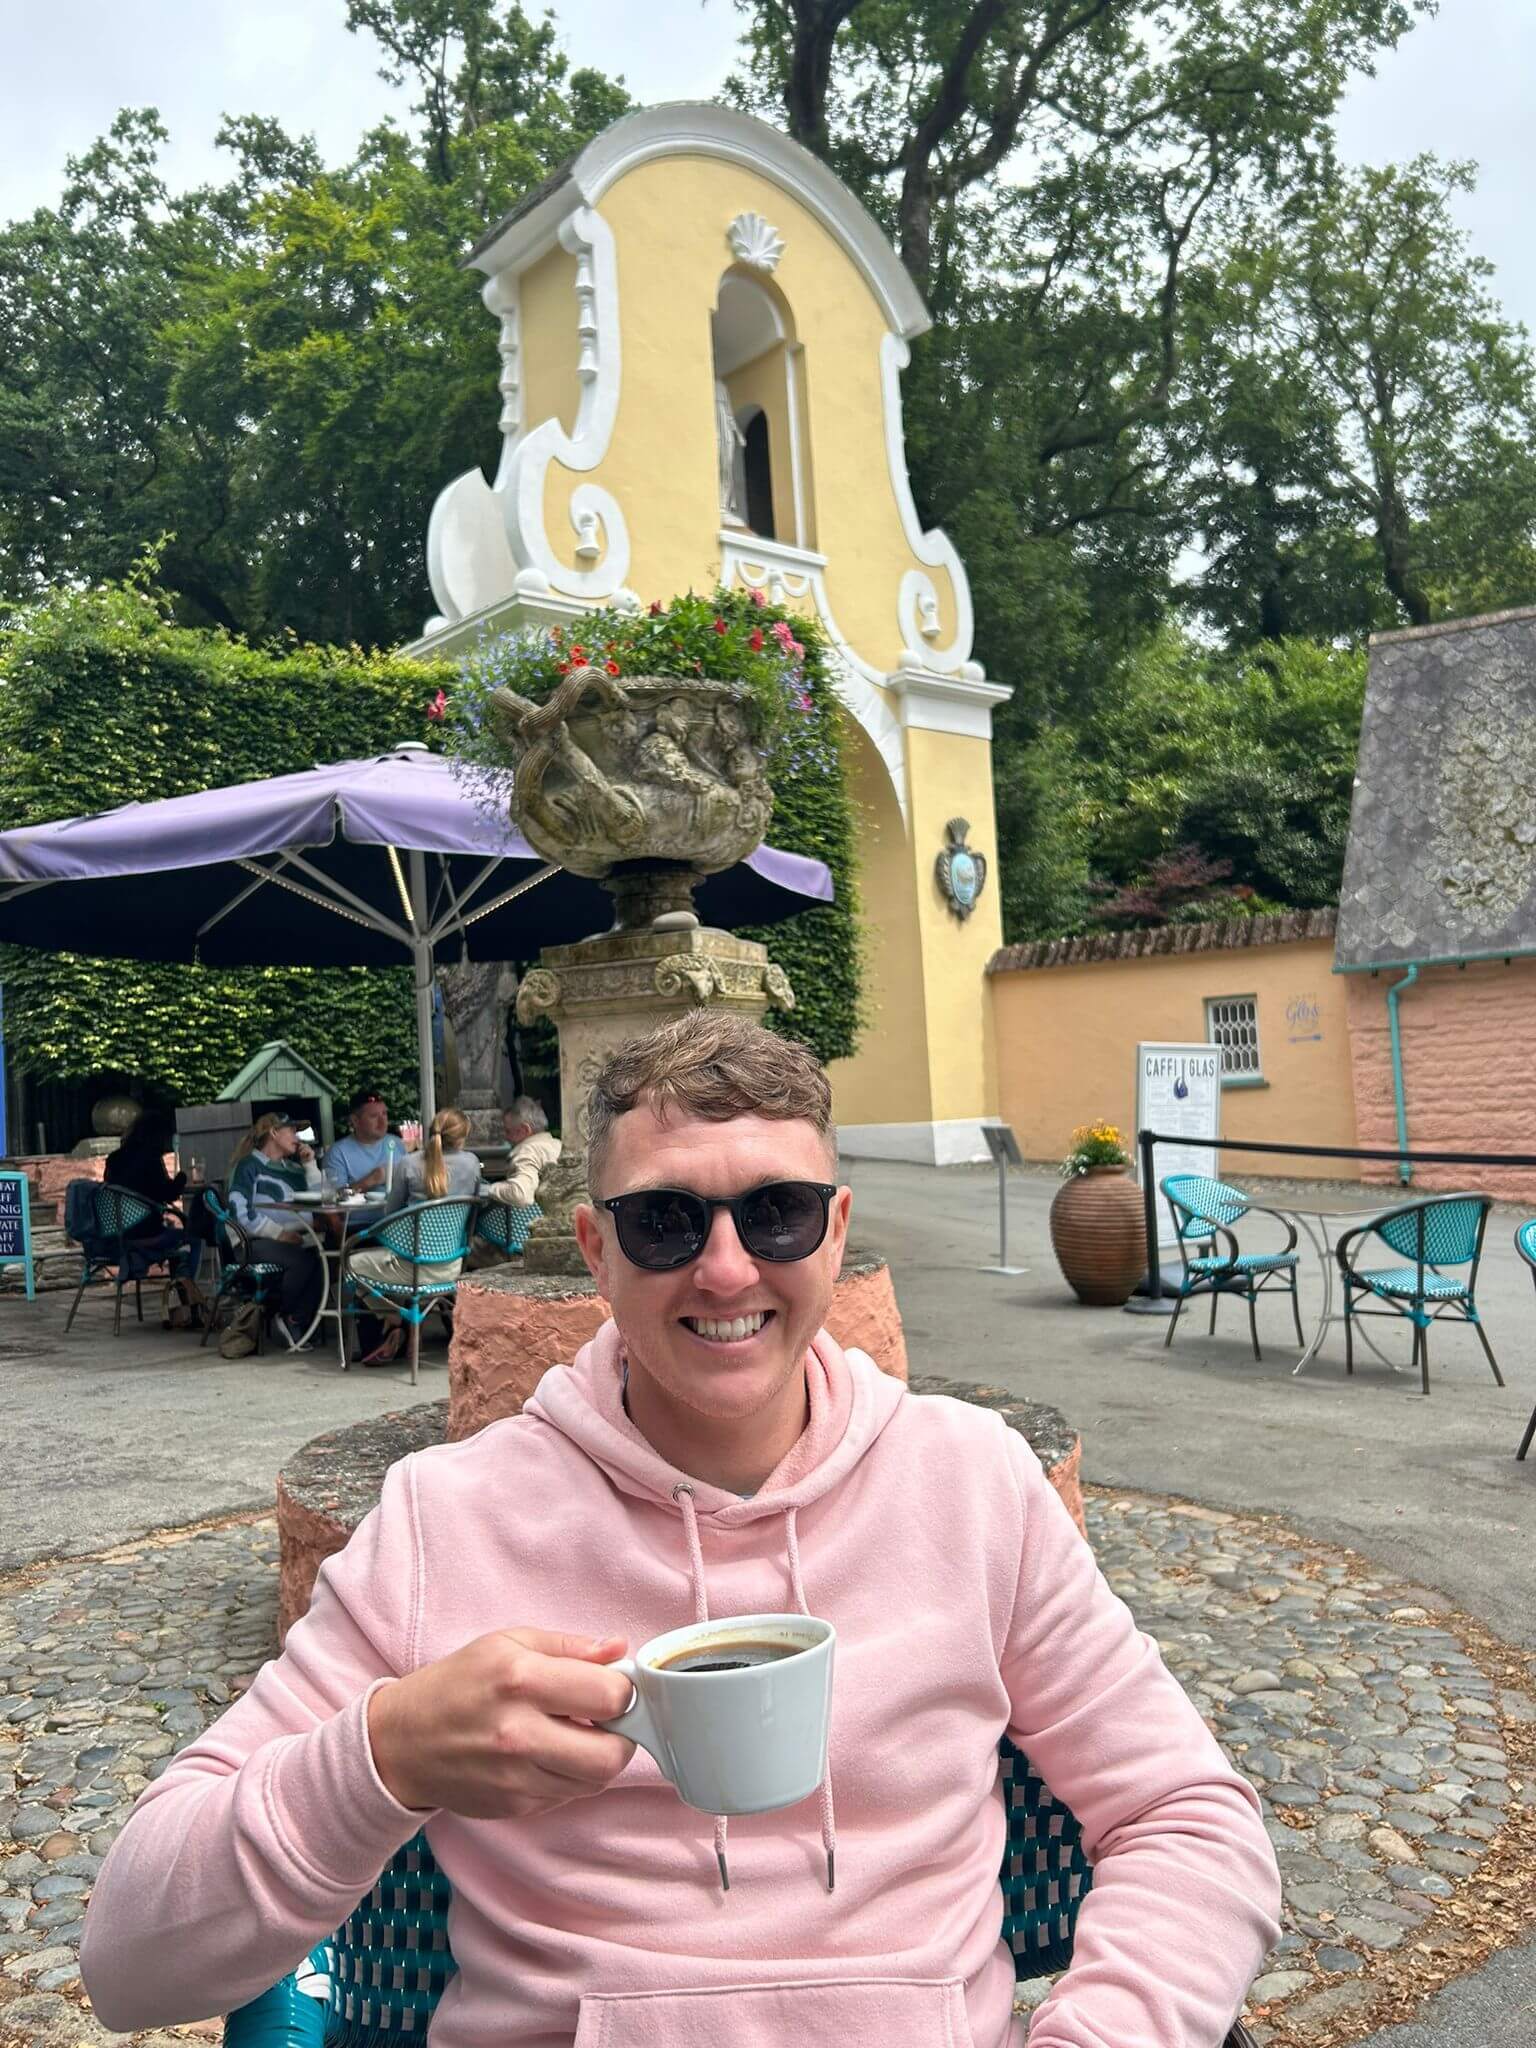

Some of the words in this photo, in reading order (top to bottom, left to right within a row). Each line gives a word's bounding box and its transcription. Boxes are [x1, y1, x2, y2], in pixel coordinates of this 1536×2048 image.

[1146, 1058, 1177, 1077] CAFFI
[1189, 1058, 1215, 1077] GLAS
[0, 1220, 20, 1230] ATE
